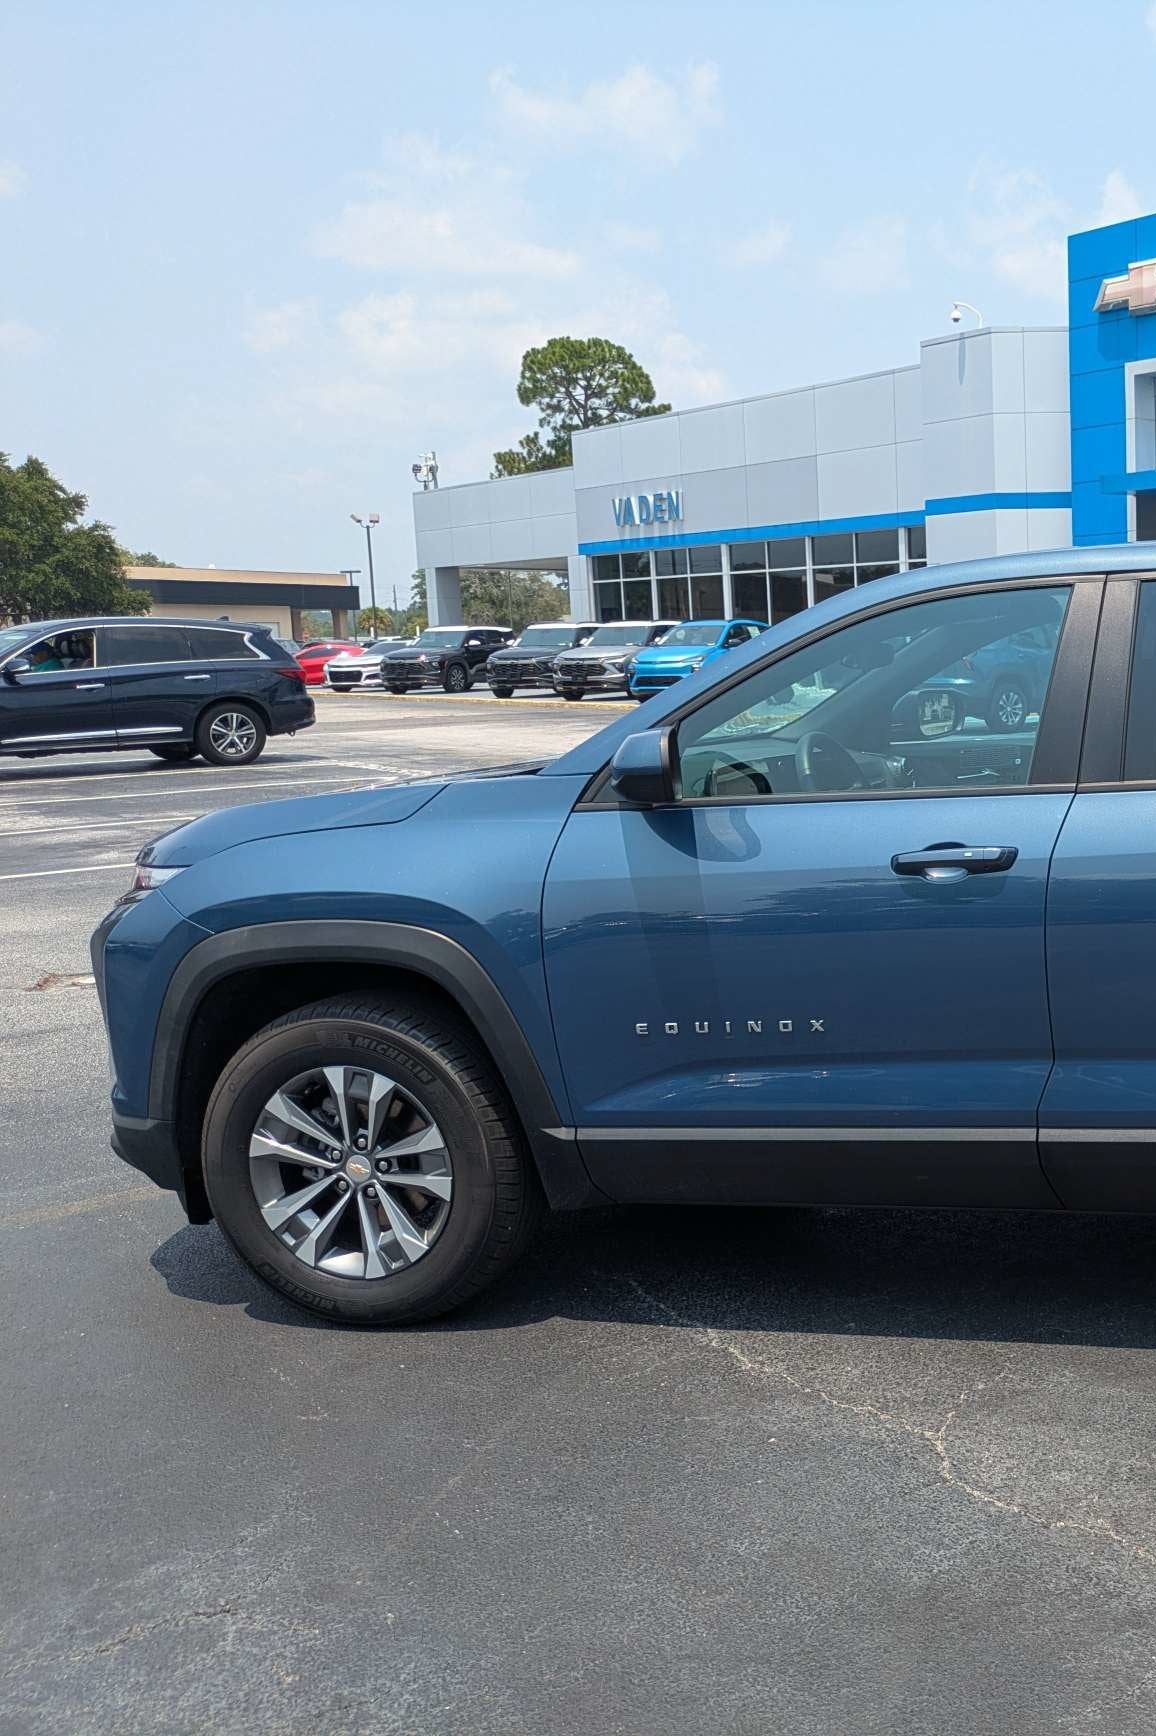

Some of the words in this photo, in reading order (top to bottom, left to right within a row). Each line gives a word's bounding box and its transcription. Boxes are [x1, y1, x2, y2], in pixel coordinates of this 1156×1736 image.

[612, 490, 684, 528] VADEN
[635, 1019, 825, 1035] EQUINOX
[353, 1035, 435, 1085] MICHELIN
